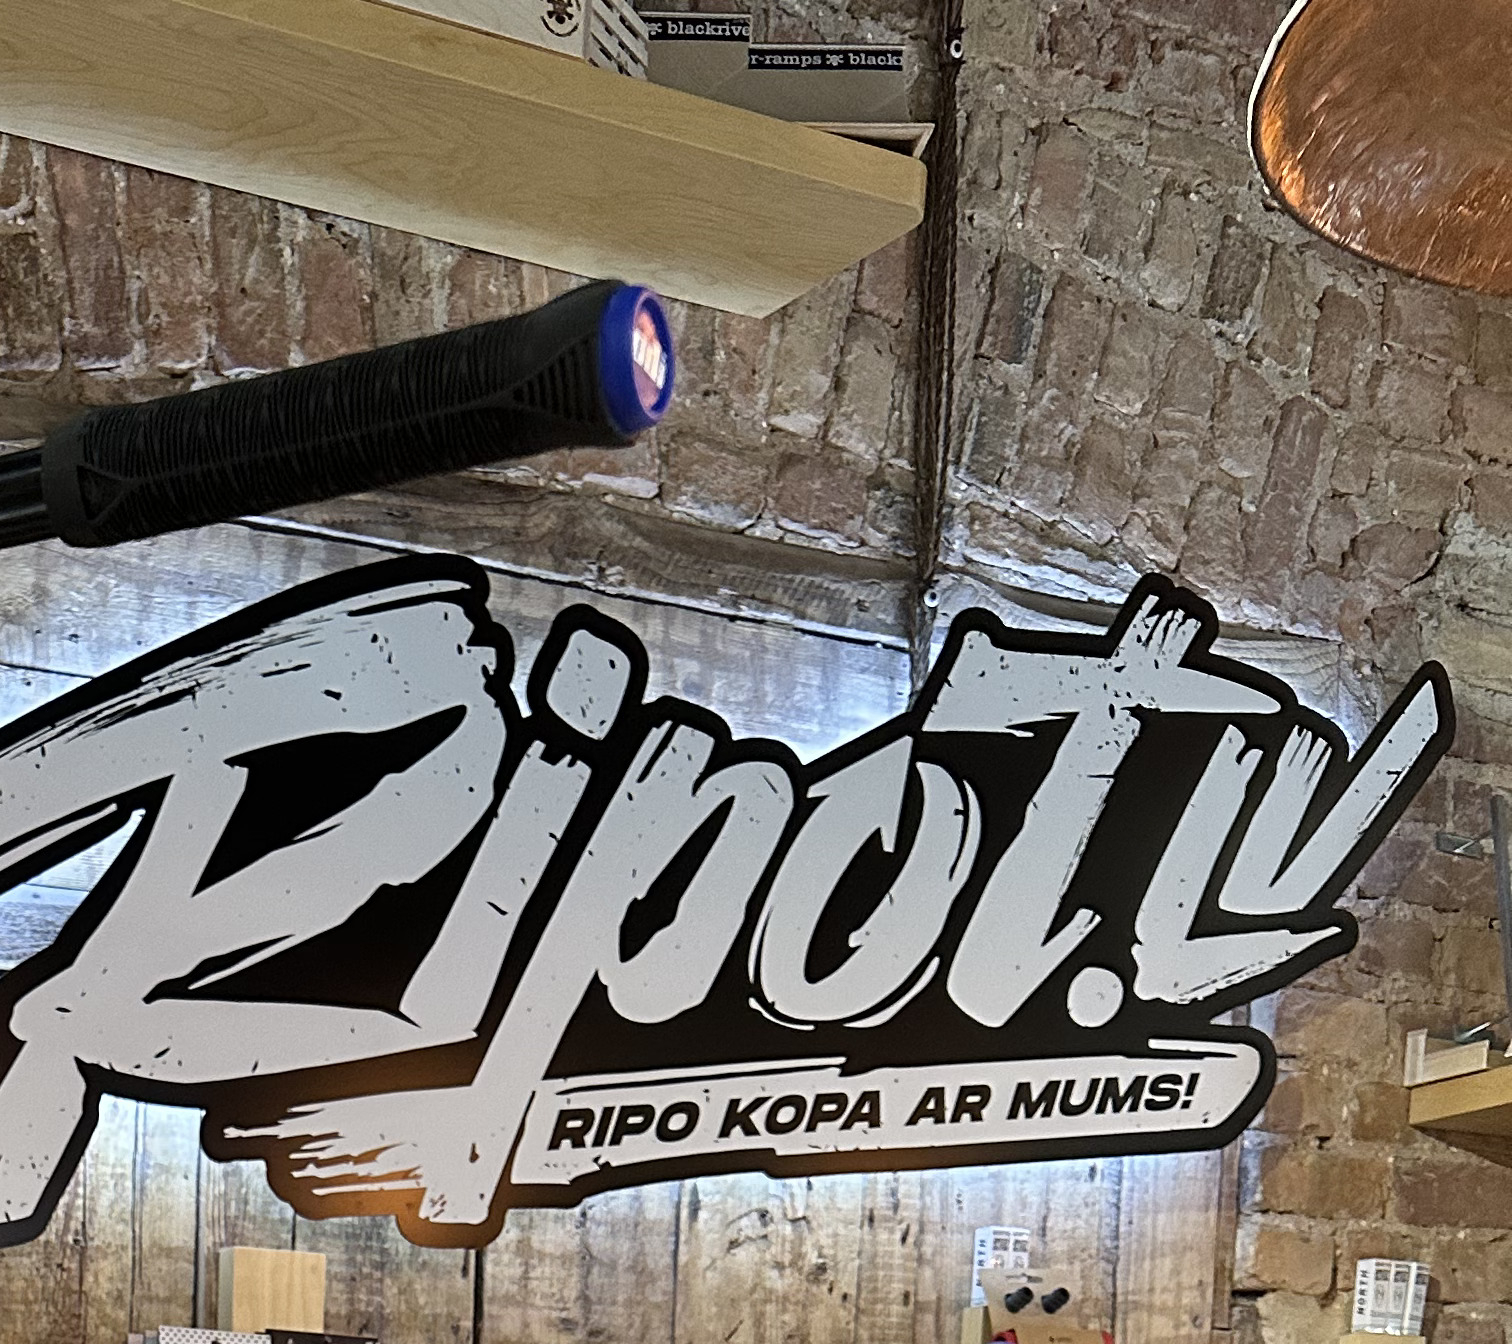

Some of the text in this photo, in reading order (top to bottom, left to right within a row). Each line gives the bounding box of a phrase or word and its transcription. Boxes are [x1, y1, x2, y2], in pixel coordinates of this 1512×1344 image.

[546, 1072, 1202, 1152] RIPO KOPA AR MUMS!
